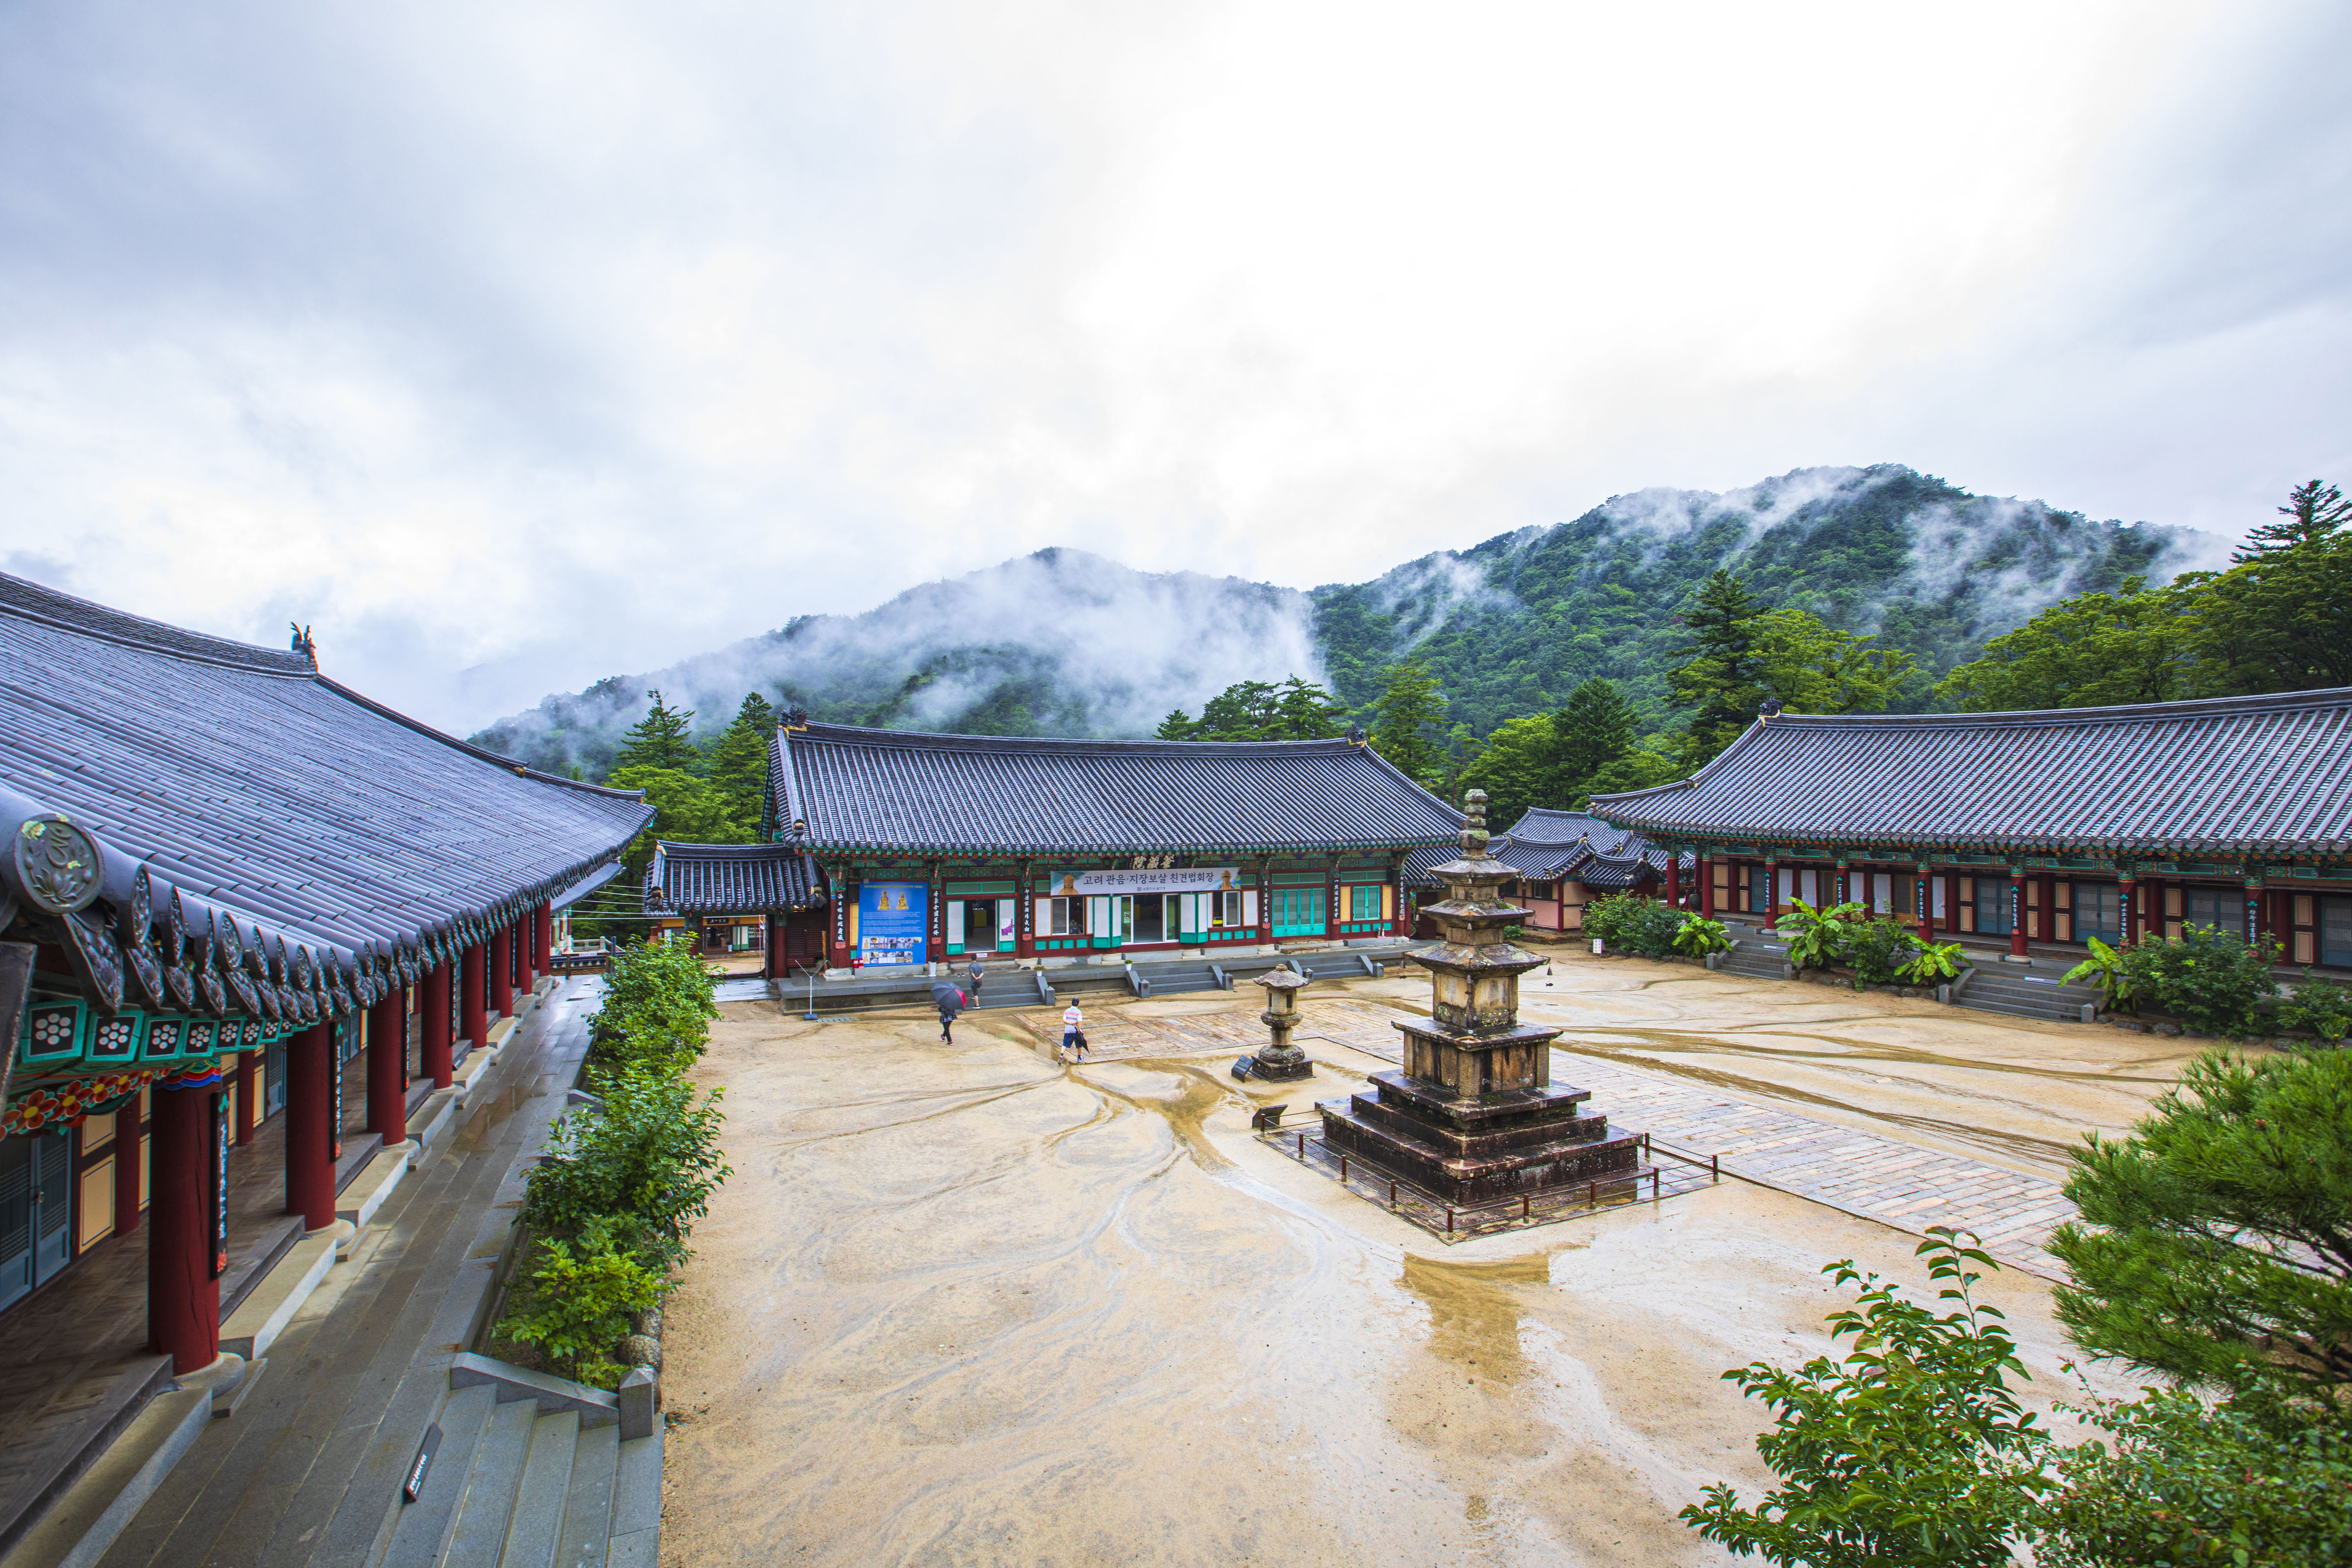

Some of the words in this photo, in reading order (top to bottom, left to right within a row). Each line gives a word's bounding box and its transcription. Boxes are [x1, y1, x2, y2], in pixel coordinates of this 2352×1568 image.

[1083, 875, 1103, 885] 고려
[1106, 873, 1167, 885] 관음·지장보살
[1170, 872, 1214, 883] 친견법회장
